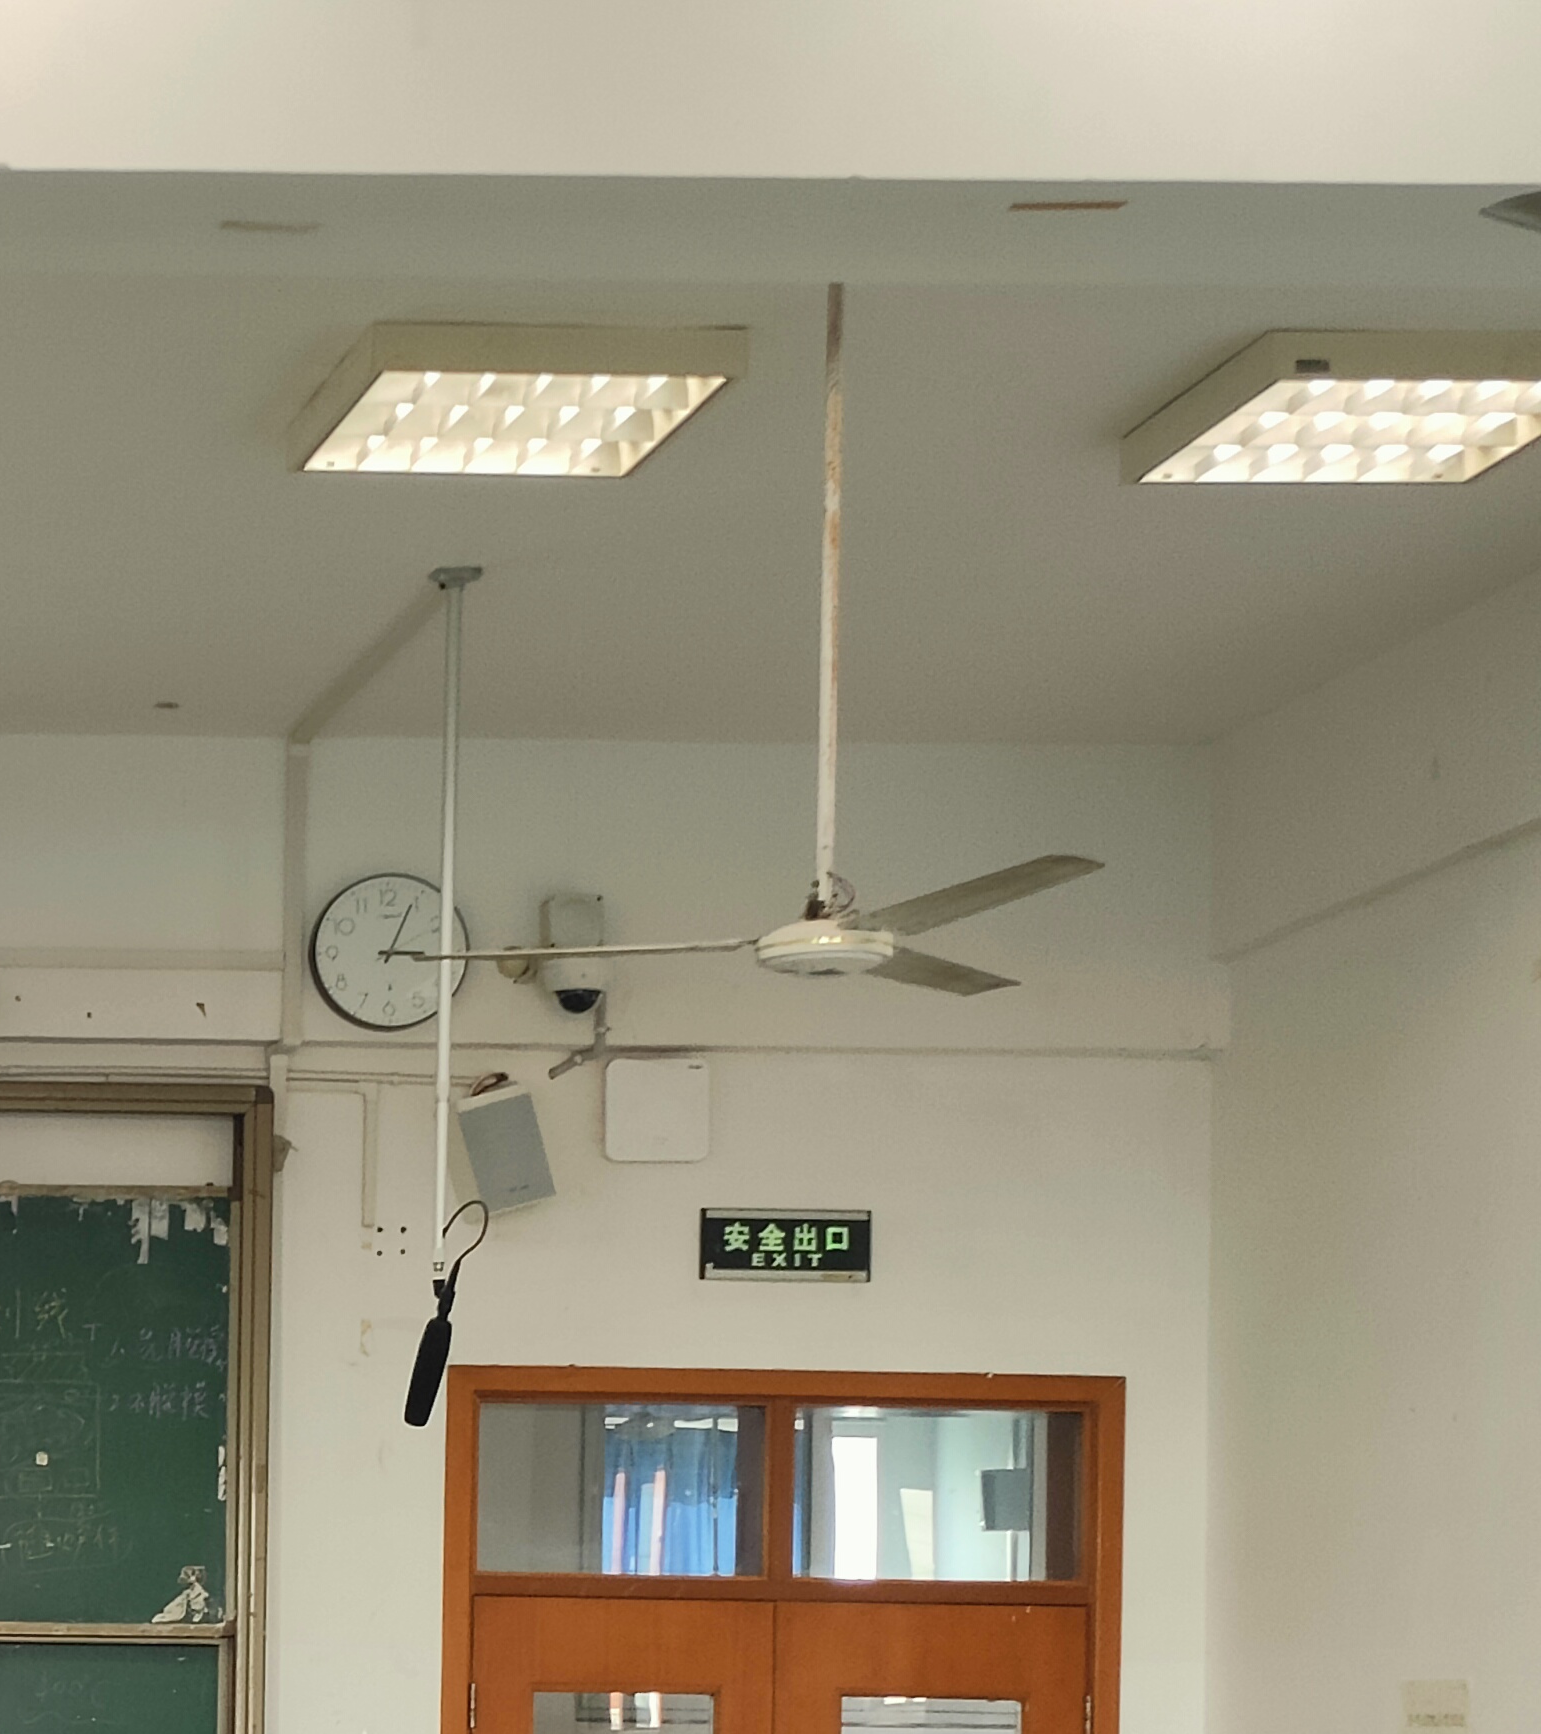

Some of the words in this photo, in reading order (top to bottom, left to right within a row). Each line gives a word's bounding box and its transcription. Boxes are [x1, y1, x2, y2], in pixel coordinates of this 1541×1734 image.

[356, 897, 367, 914] 11
[380, 889, 397, 907] 12
[333, 917, 356, 936] 10
[325, 945, 339, 961] 9
[335, 973, 347, 991] 8
[382, 1001, 396, 1018] 6
[723, 1221, 850, 1252] 安全出口
[751, 1252, 823, 1267] EXIT
